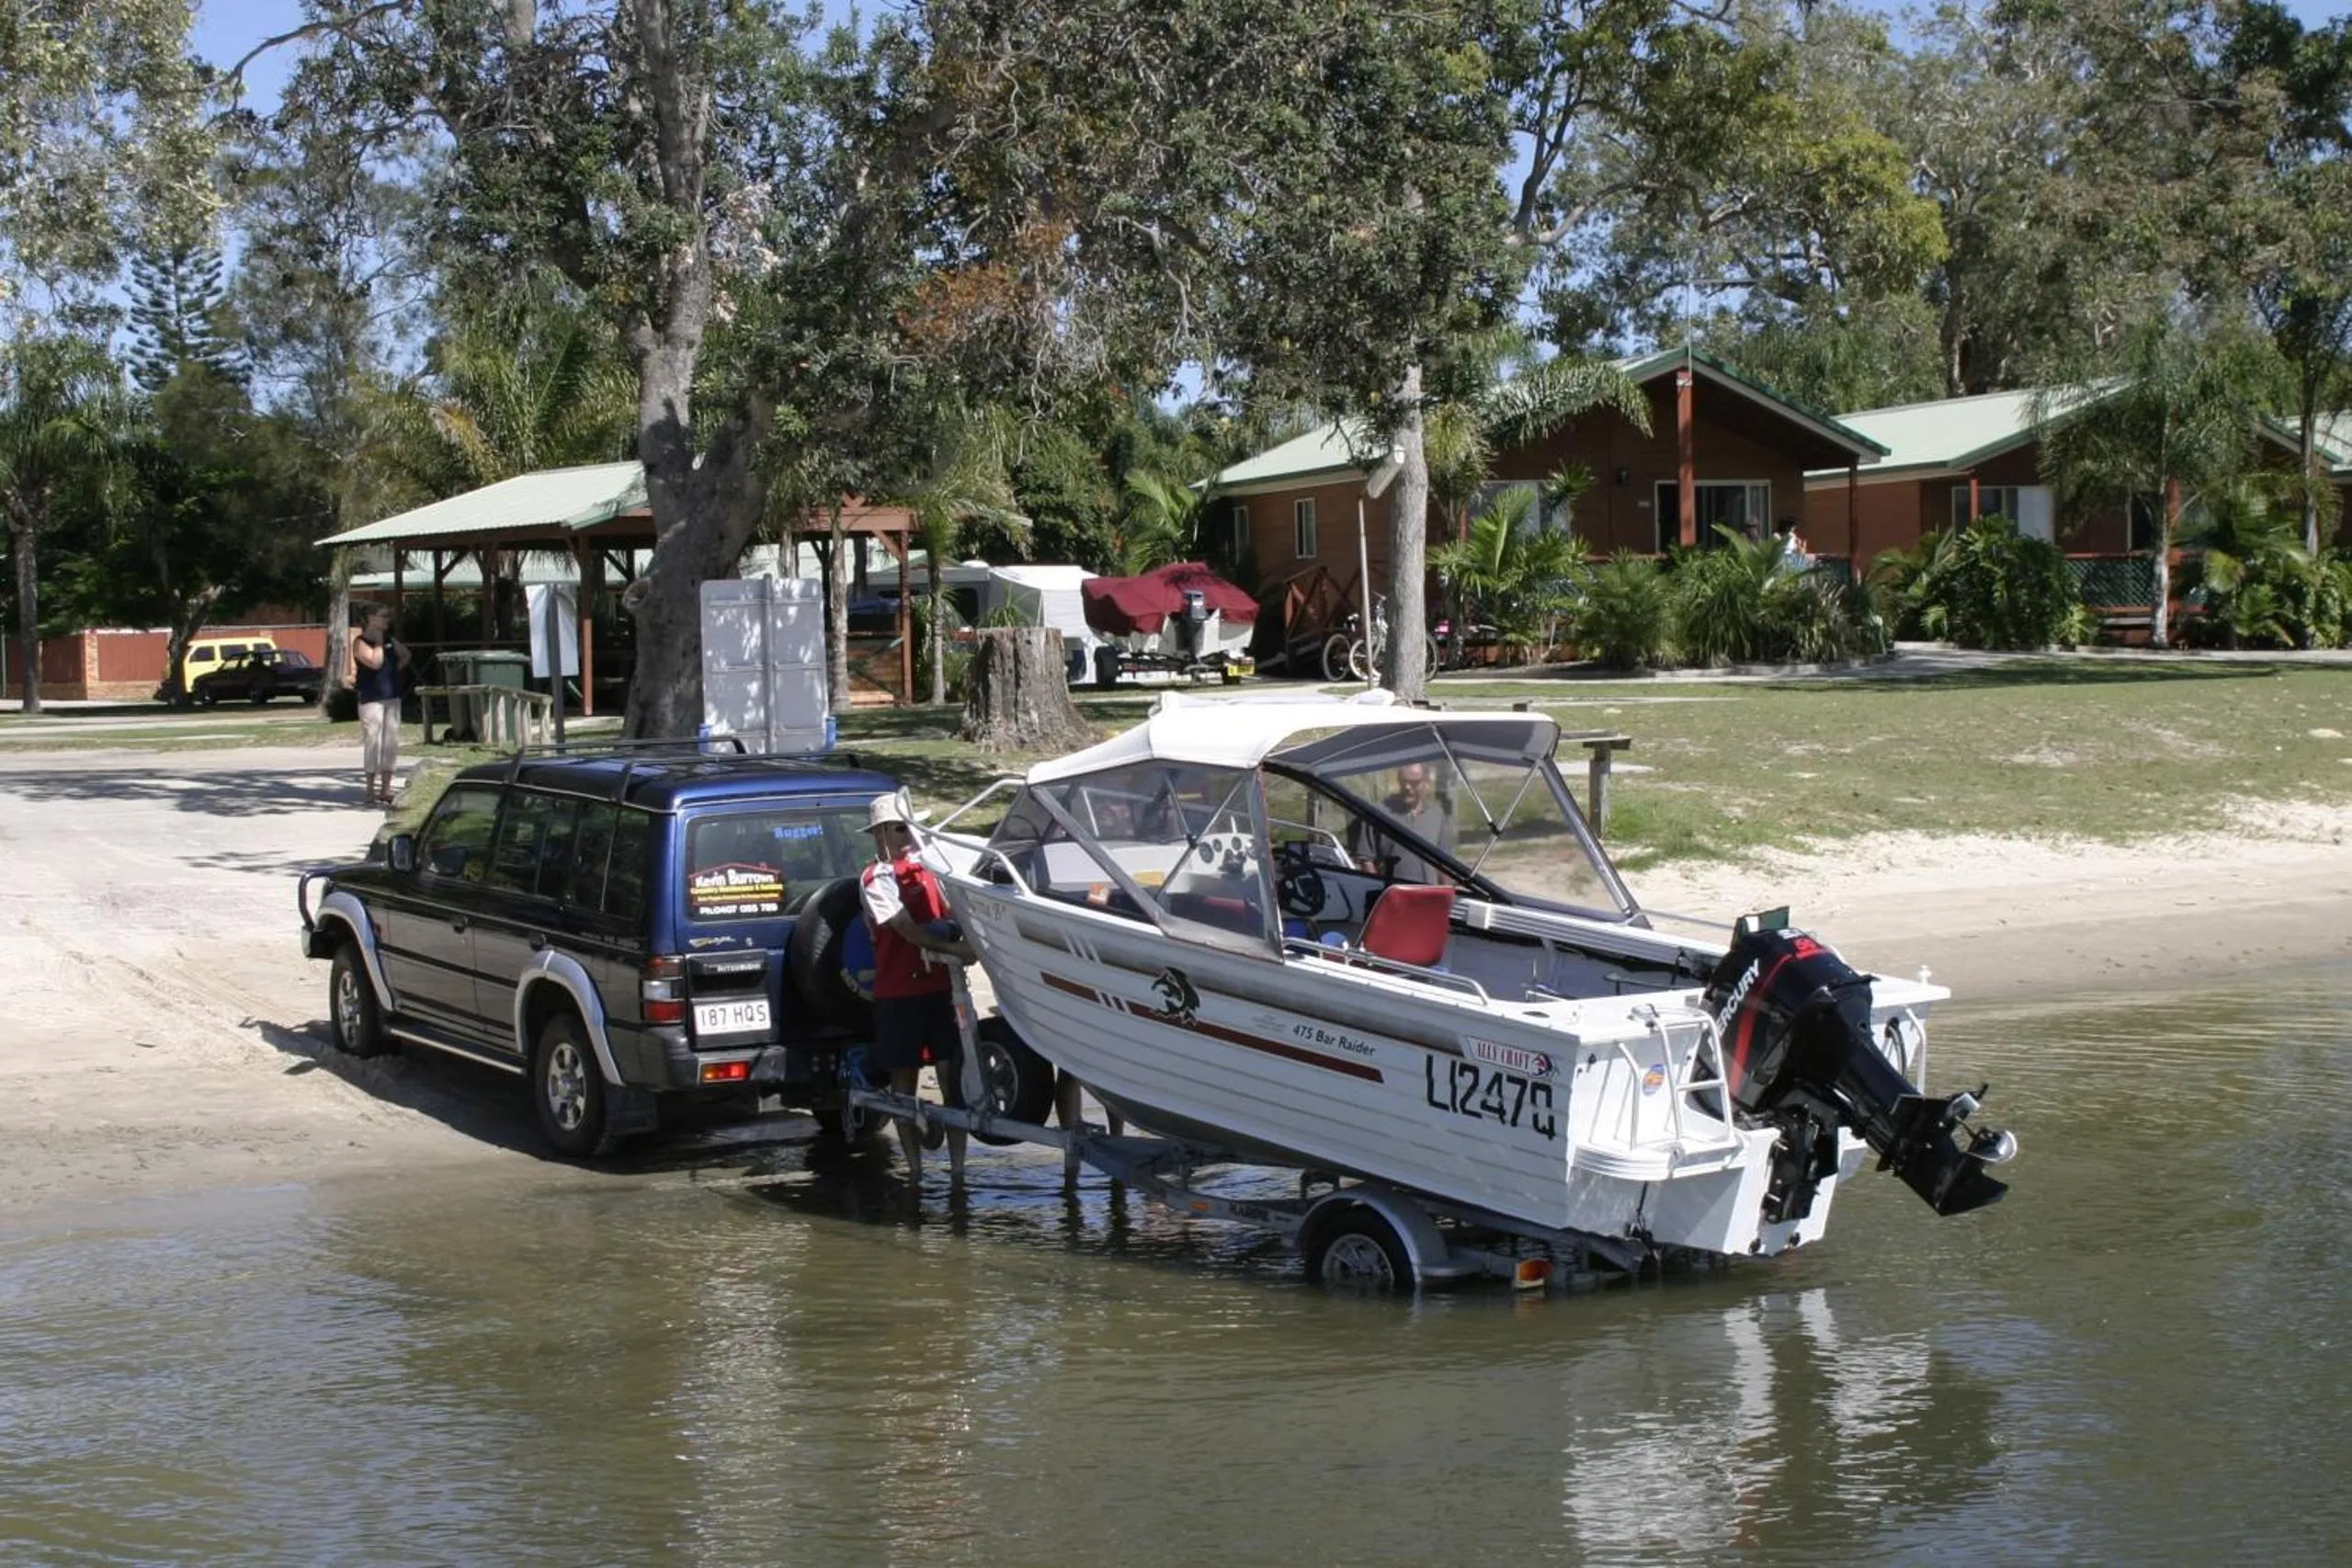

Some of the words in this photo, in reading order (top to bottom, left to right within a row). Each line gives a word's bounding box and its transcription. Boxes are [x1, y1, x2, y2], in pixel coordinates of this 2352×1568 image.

[700, 1008, 727, 1027] 187
[733, 1004, 767, 1024] HQS
[1293, 1025, 1313, 1040] 475
[1315, 1030, 1335, 1044] Bar
[1338, 1037, 1376, 1056] Raider
